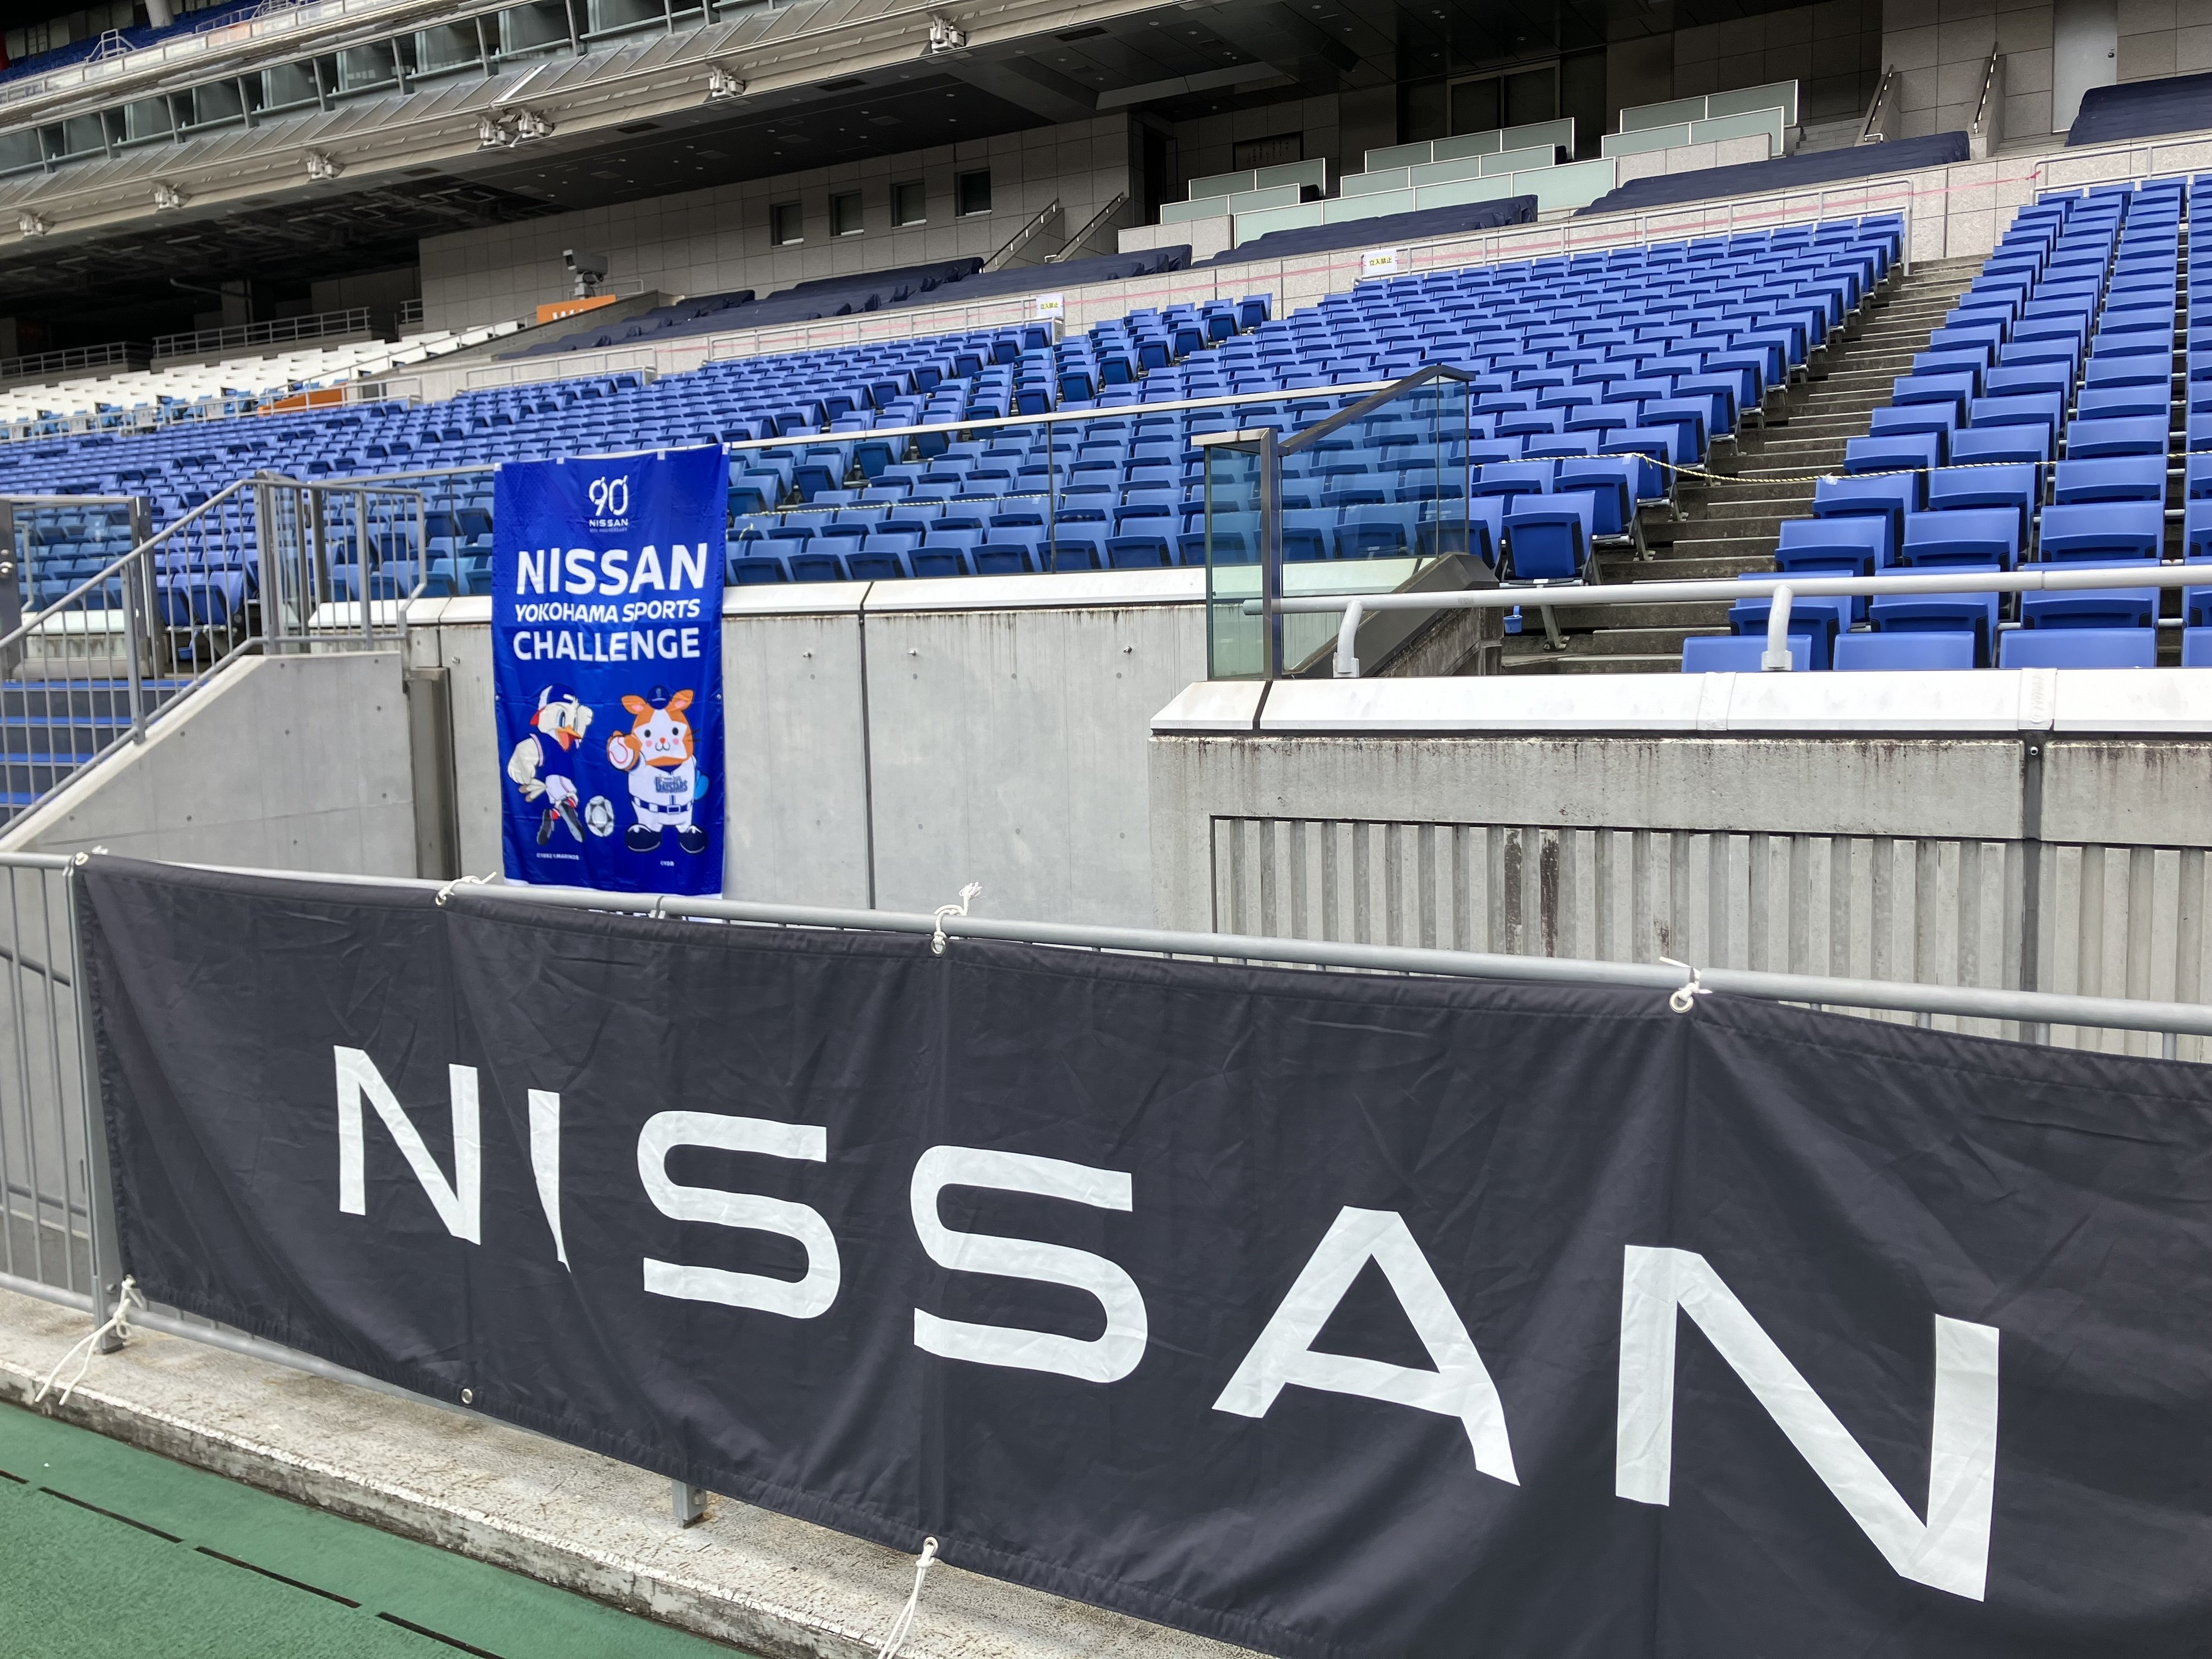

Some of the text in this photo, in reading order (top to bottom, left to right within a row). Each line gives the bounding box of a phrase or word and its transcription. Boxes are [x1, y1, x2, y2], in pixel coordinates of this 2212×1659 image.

[1369, 257, 1392, 266] 立入禁止
[589, 475, 628, 516] 90
[589, 518, 628, 527] NISSAN
[516, 543, 708, 596] NISSAN
[515, 599, 701, 623] YOKOHAMA SPORTS
[513, 627, 701, 662] CHALLENGE
[333, 1045, 2000, 1602] NISSAN
